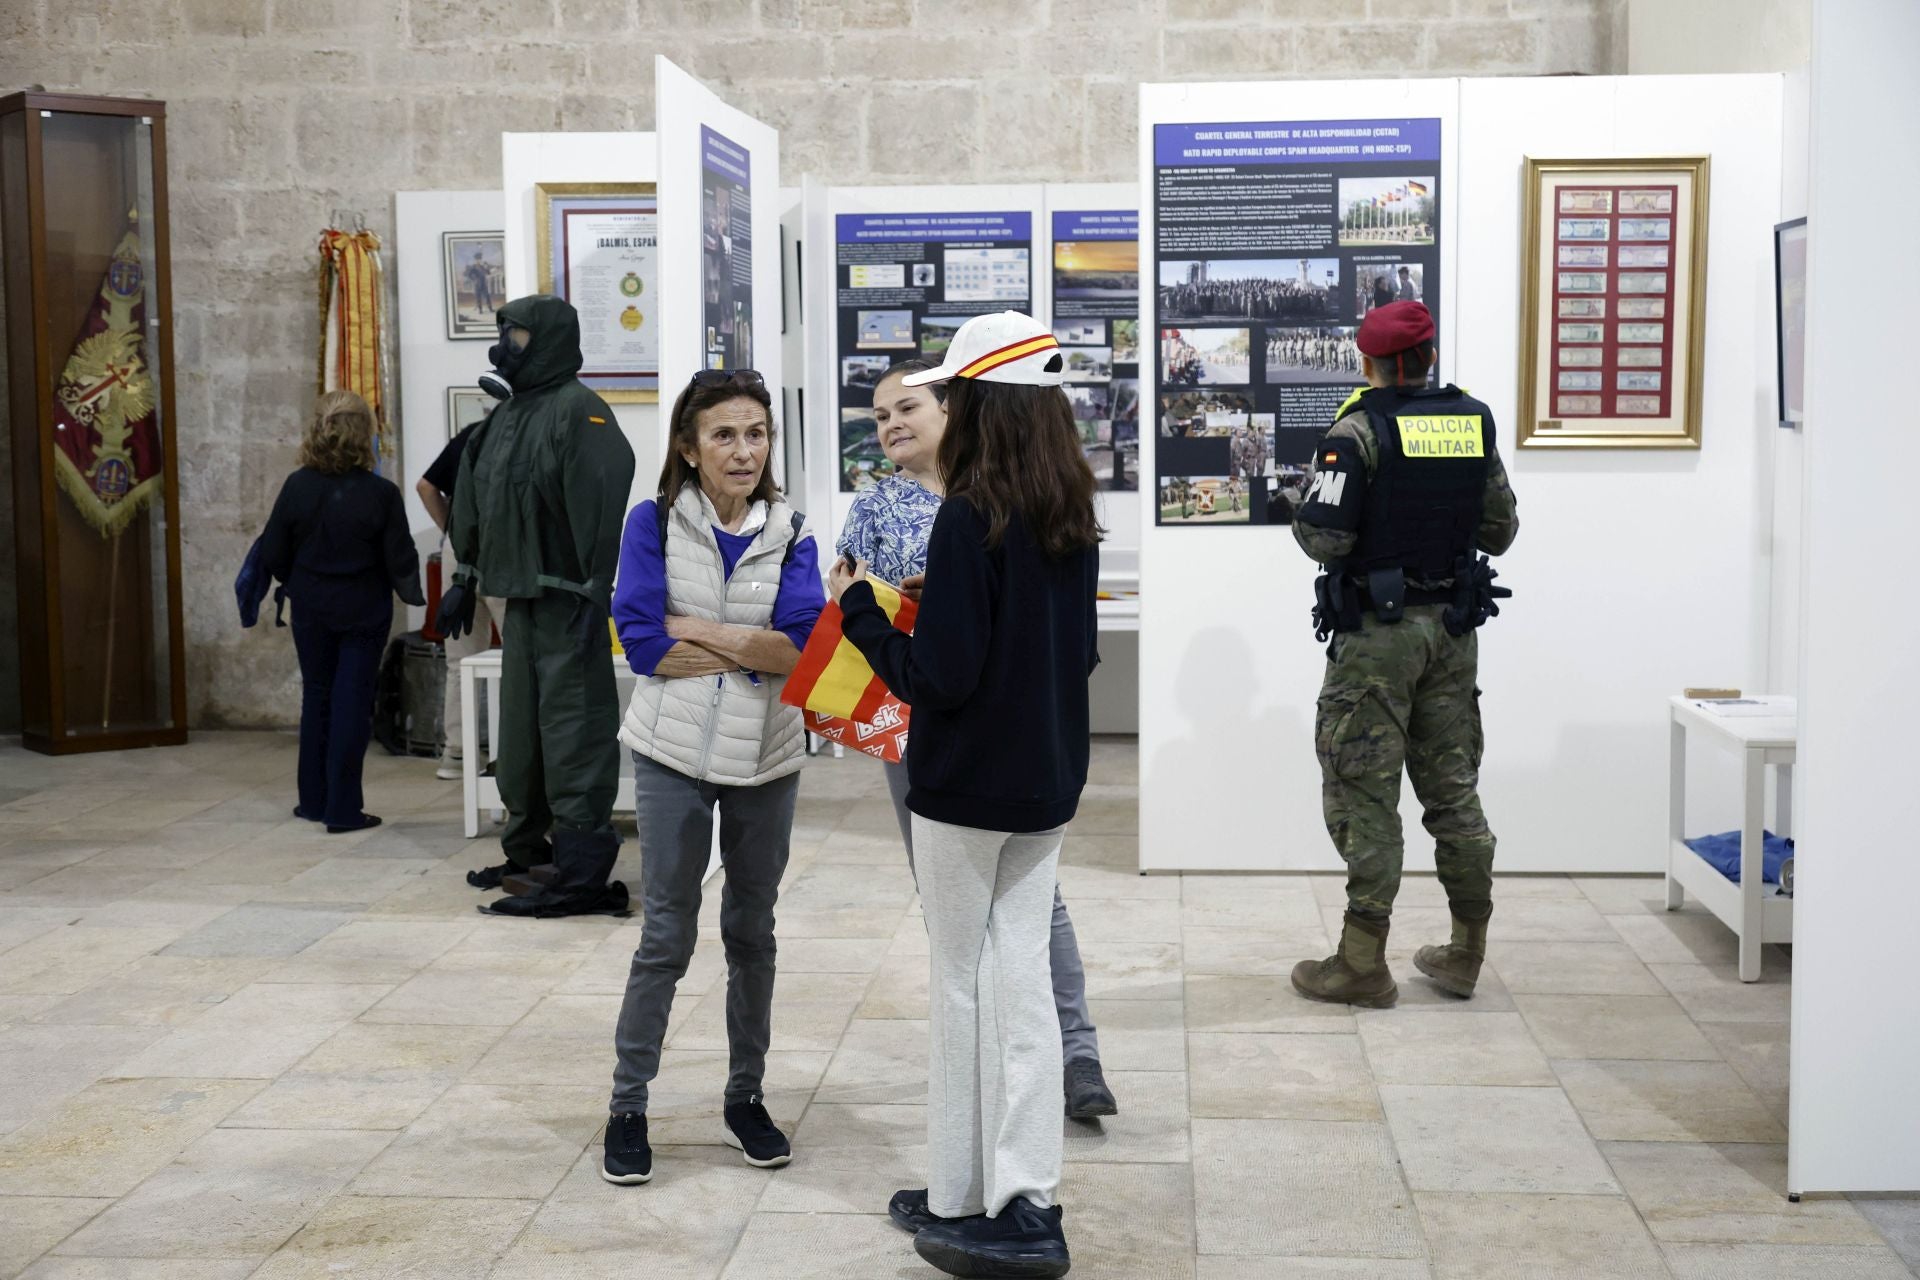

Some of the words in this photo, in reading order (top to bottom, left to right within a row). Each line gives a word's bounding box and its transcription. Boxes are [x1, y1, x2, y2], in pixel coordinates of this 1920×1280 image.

[1225, 131, 1253, 140] GENERAL
[1292, 130, 1302, 138] DE
[1302, 129, 1318, 138] ALTA
[1183, 149, 1200, 157] NATO
[1202, 148, 1222, 157] RAPID
[1223, 147, 1262, 157] DEPLOYABLE
[1264, 147, 1286, 156] CORPS
[1288, 146, 1307, 155] SPAIN
[1308, 145, 1359, 155] HEADQUARTERS
[1404, 419, 1475, 433] POLICIA
[1408, 440, 1475, 454] MILITAR
[1305, 471, 1347, 507] PM
[856, 705, 902, 740] bsk
